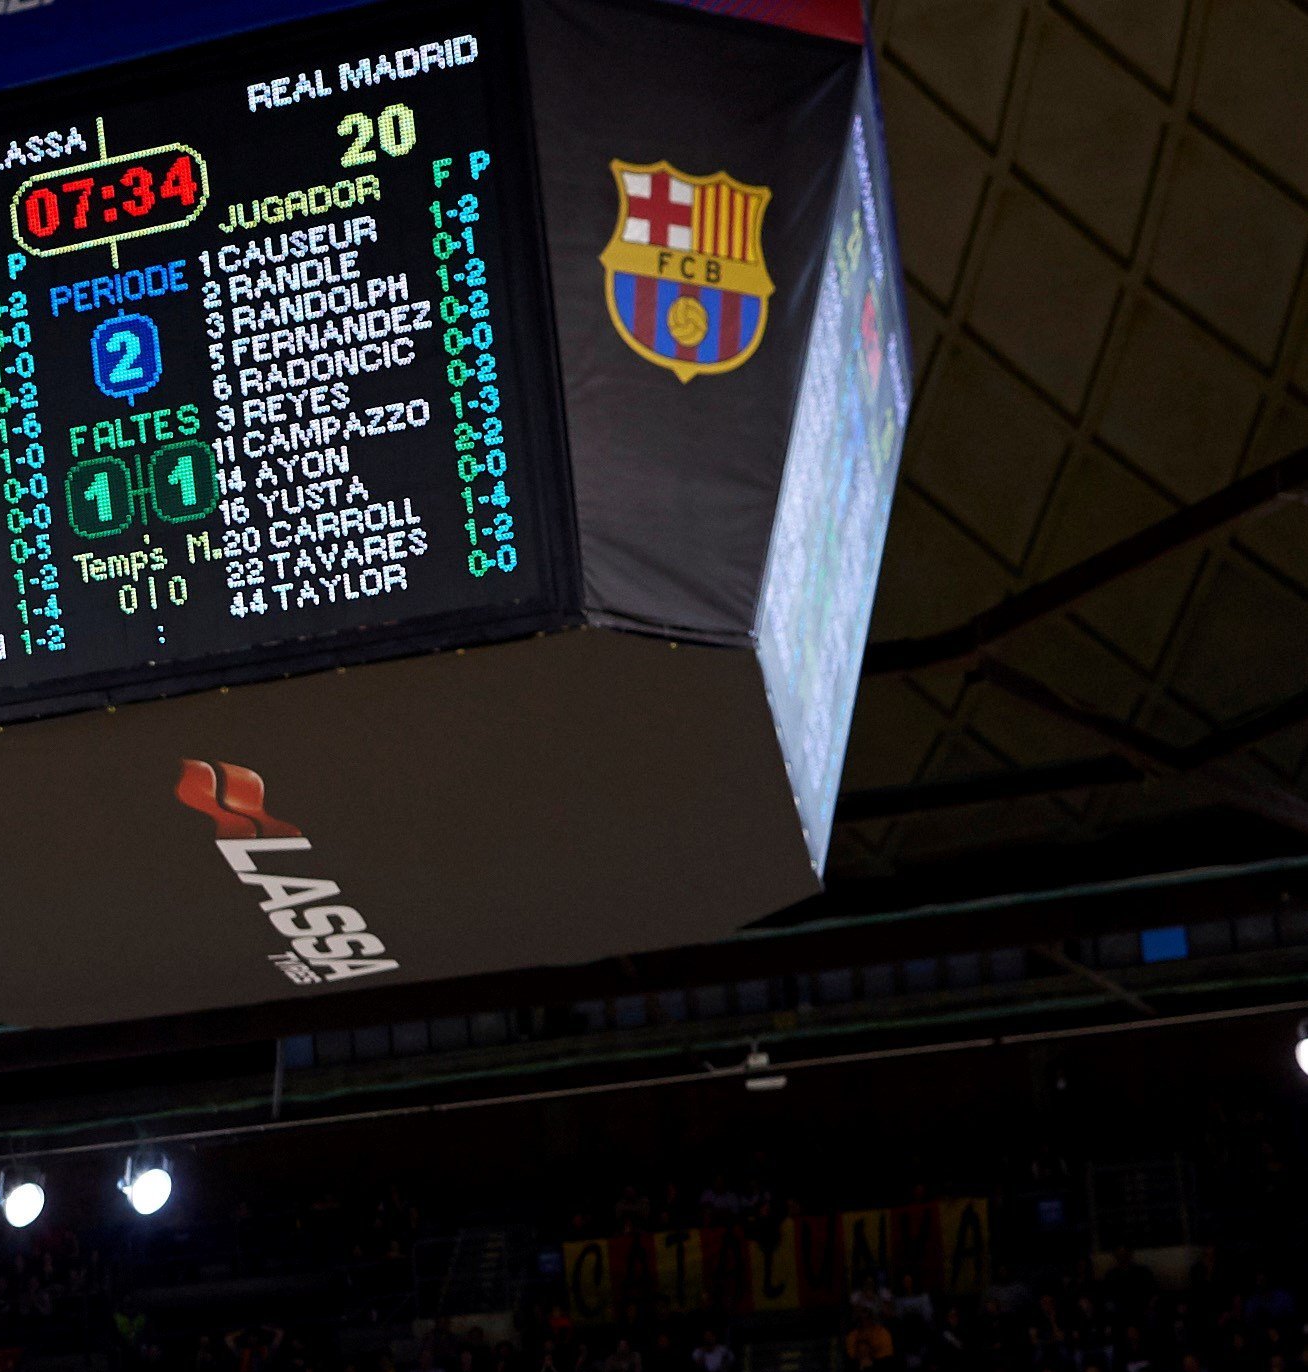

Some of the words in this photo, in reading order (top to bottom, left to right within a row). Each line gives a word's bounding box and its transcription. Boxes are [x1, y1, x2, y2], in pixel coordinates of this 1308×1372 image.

[247, 69, 332, 112] REAL
[338, 34, 478, 91] MADRID
[337, 102, 416, 168] 20
[25, 156, 195, 238] 07:34
[219, 174, 381, 233] JUGADOR
[432, 158, 452, 188] F
[469, 150, 490, 180] P
[7, 252, 26, 279] P
[198, 250, 211, 277] 1
[218, 216, 377, 273] CAUSEUR
[50, 259, 189, 317] PERIODE
[202, 281, 222, 310] 2
[228, 250, 361, 303] RANDLE
[206, 312, 225, 340] 3
[232, 273, 409, 335] RANDOLPH
[105, 330, 144, 383] 2
[209, 343, 225, 371] 5
[232, 300, 433, 366] FERNANDEZ
[212, 373, 232, 401] 6
[239, 337, 415, 396] RADONCIC
[70, 403, 200, 457] FALTES
[212, 436, 235, 464] 11
[242, 398, 430, 458] CAMPAZZO
[217, 405, 235, 432] 9
[243, 382, 350, 427] REYES
[84, 472, 113, 522] 1
[168, 455, 197, 506] 1
[216, 465, 246, 495] 14
[255, 445, 350, 488] AYON
[219, 497, 249, 526] 16
[257, 476, 369, 518] YUSTA
[222, 527, 261, 558] 20
[268, 498, 420, 548] CARROLL
[225, 558, 265, 588] 22
[268, 528, 428, 579] TAVARES
[230, 589, 268, 618] 44
[272, 563, 407, 611] TAYLOR
[215, 836, 399, 982] LASSA
